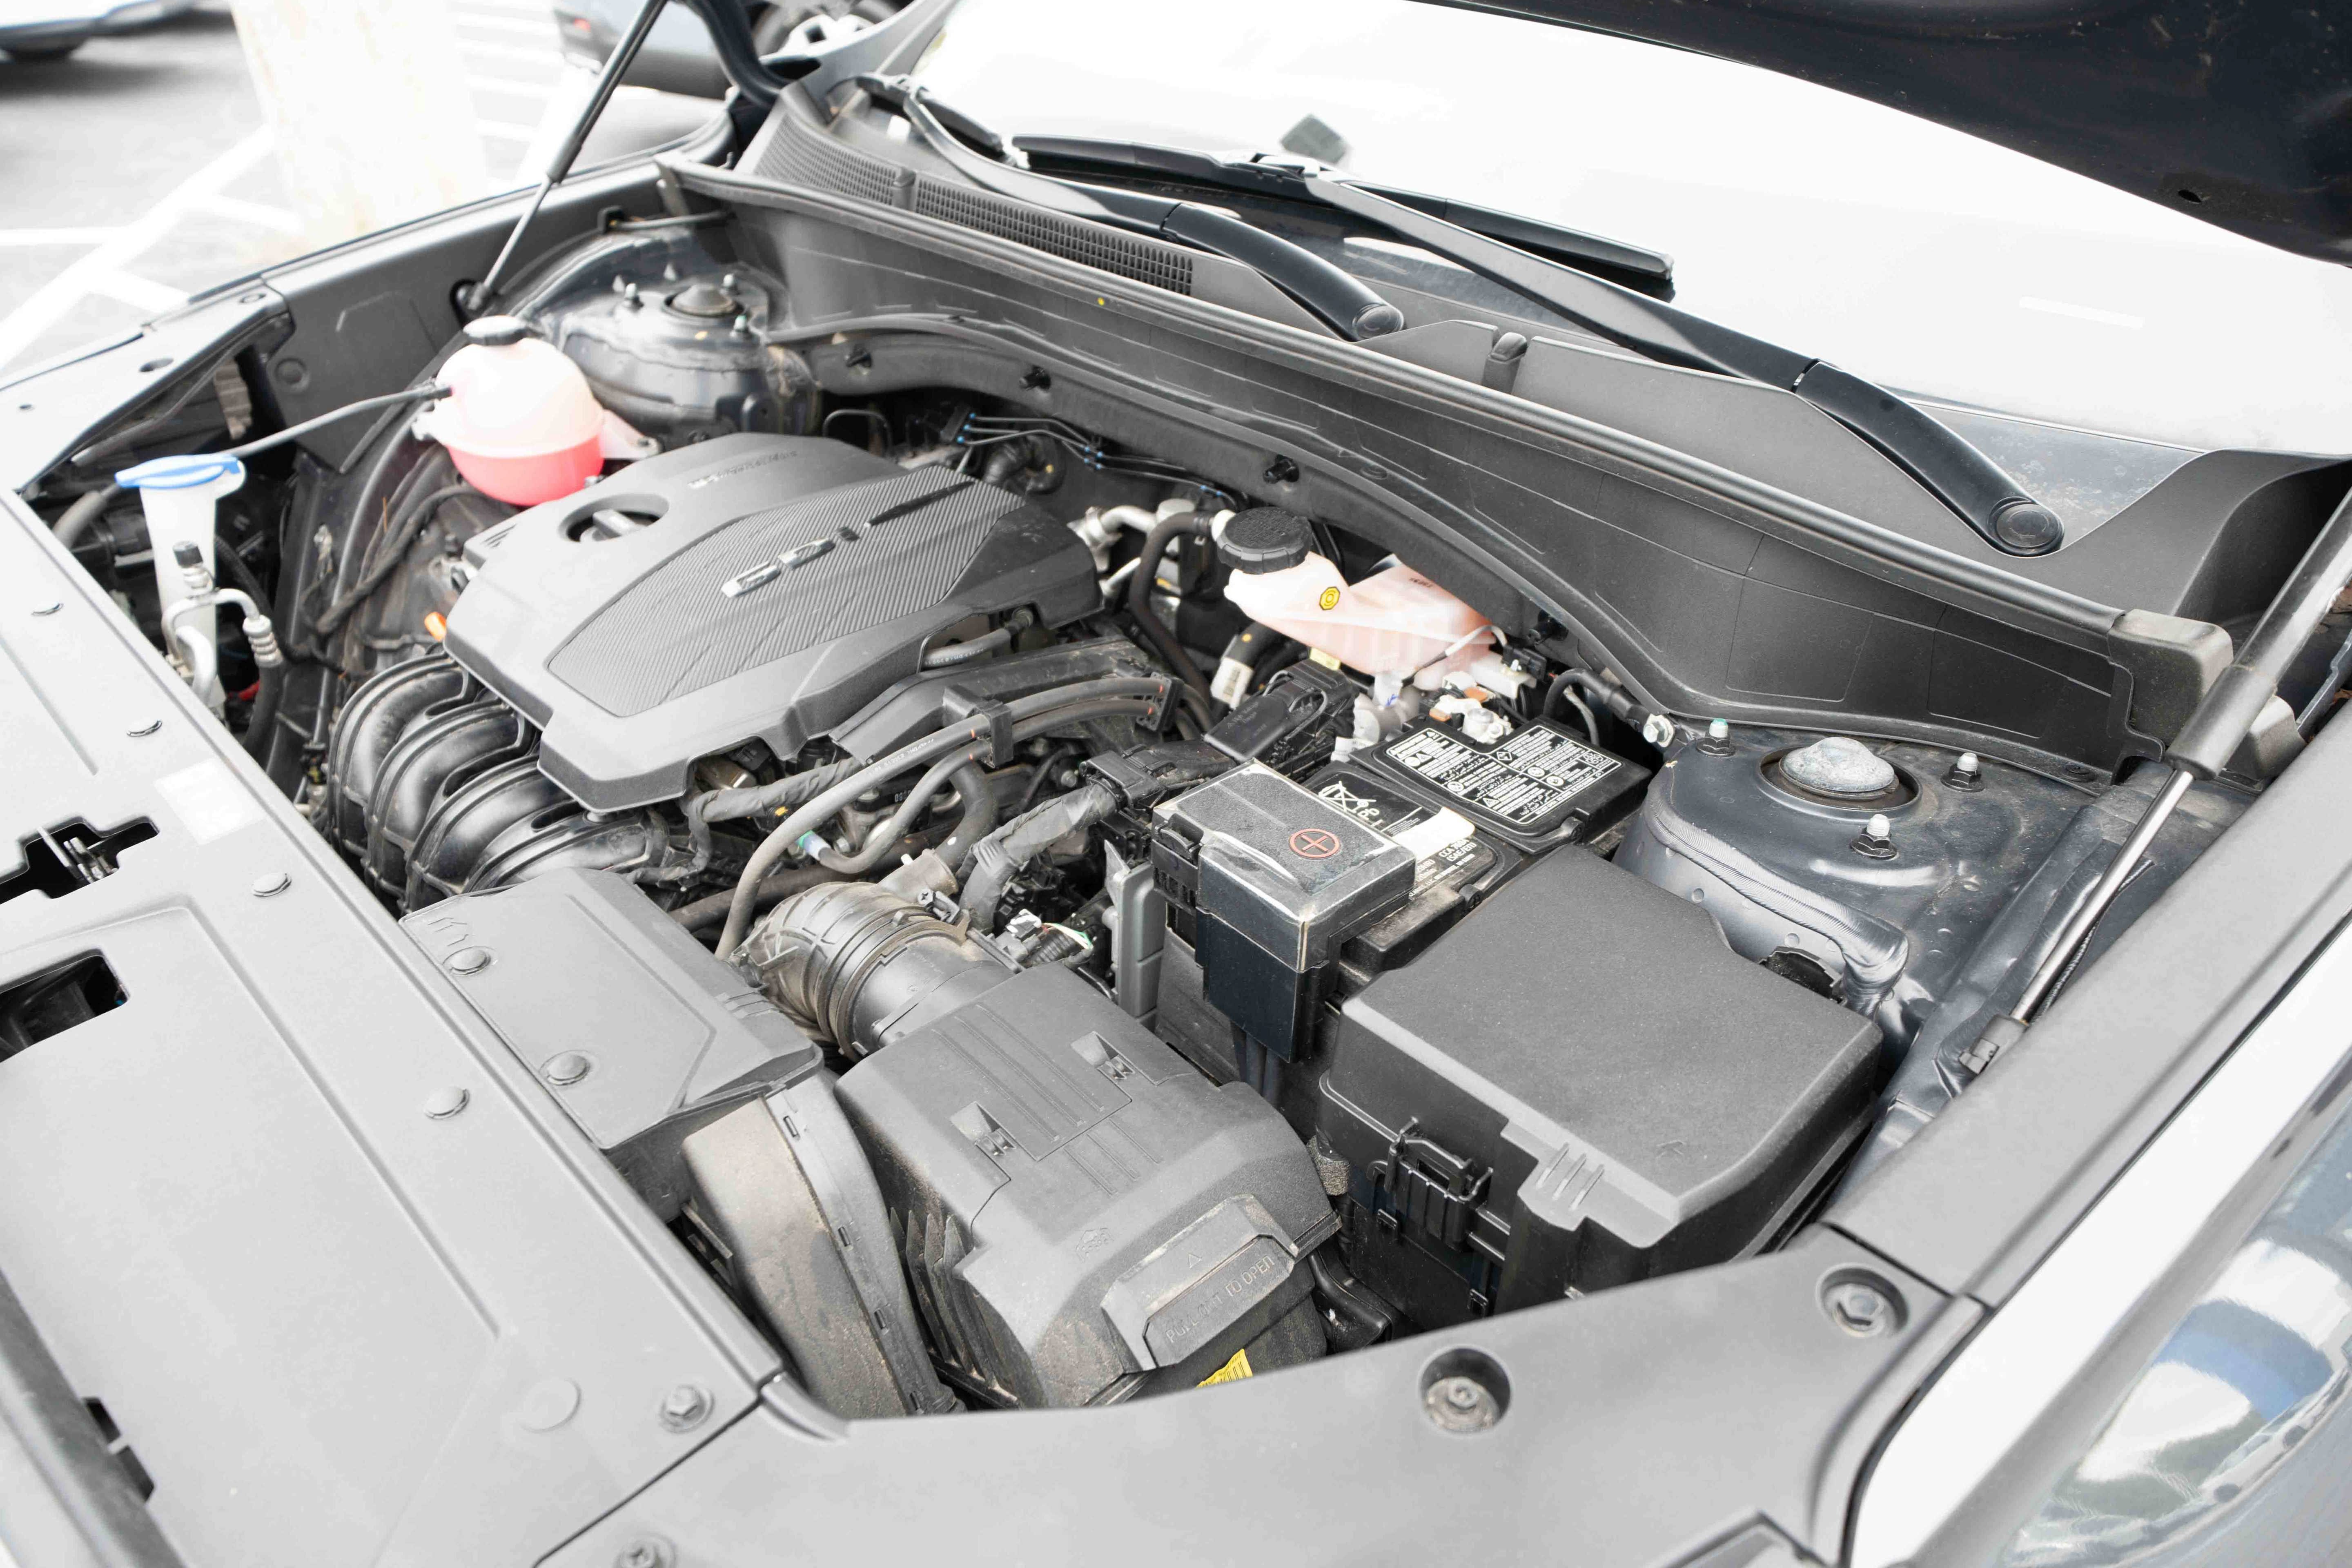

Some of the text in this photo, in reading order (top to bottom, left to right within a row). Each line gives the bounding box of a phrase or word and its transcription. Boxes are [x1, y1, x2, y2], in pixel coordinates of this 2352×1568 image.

[1166, 1314, 1199, 1343] PULL
[1225, 1279, 1242, 1297] TO
[1242, 1255, 1275, 1285] OPEN
